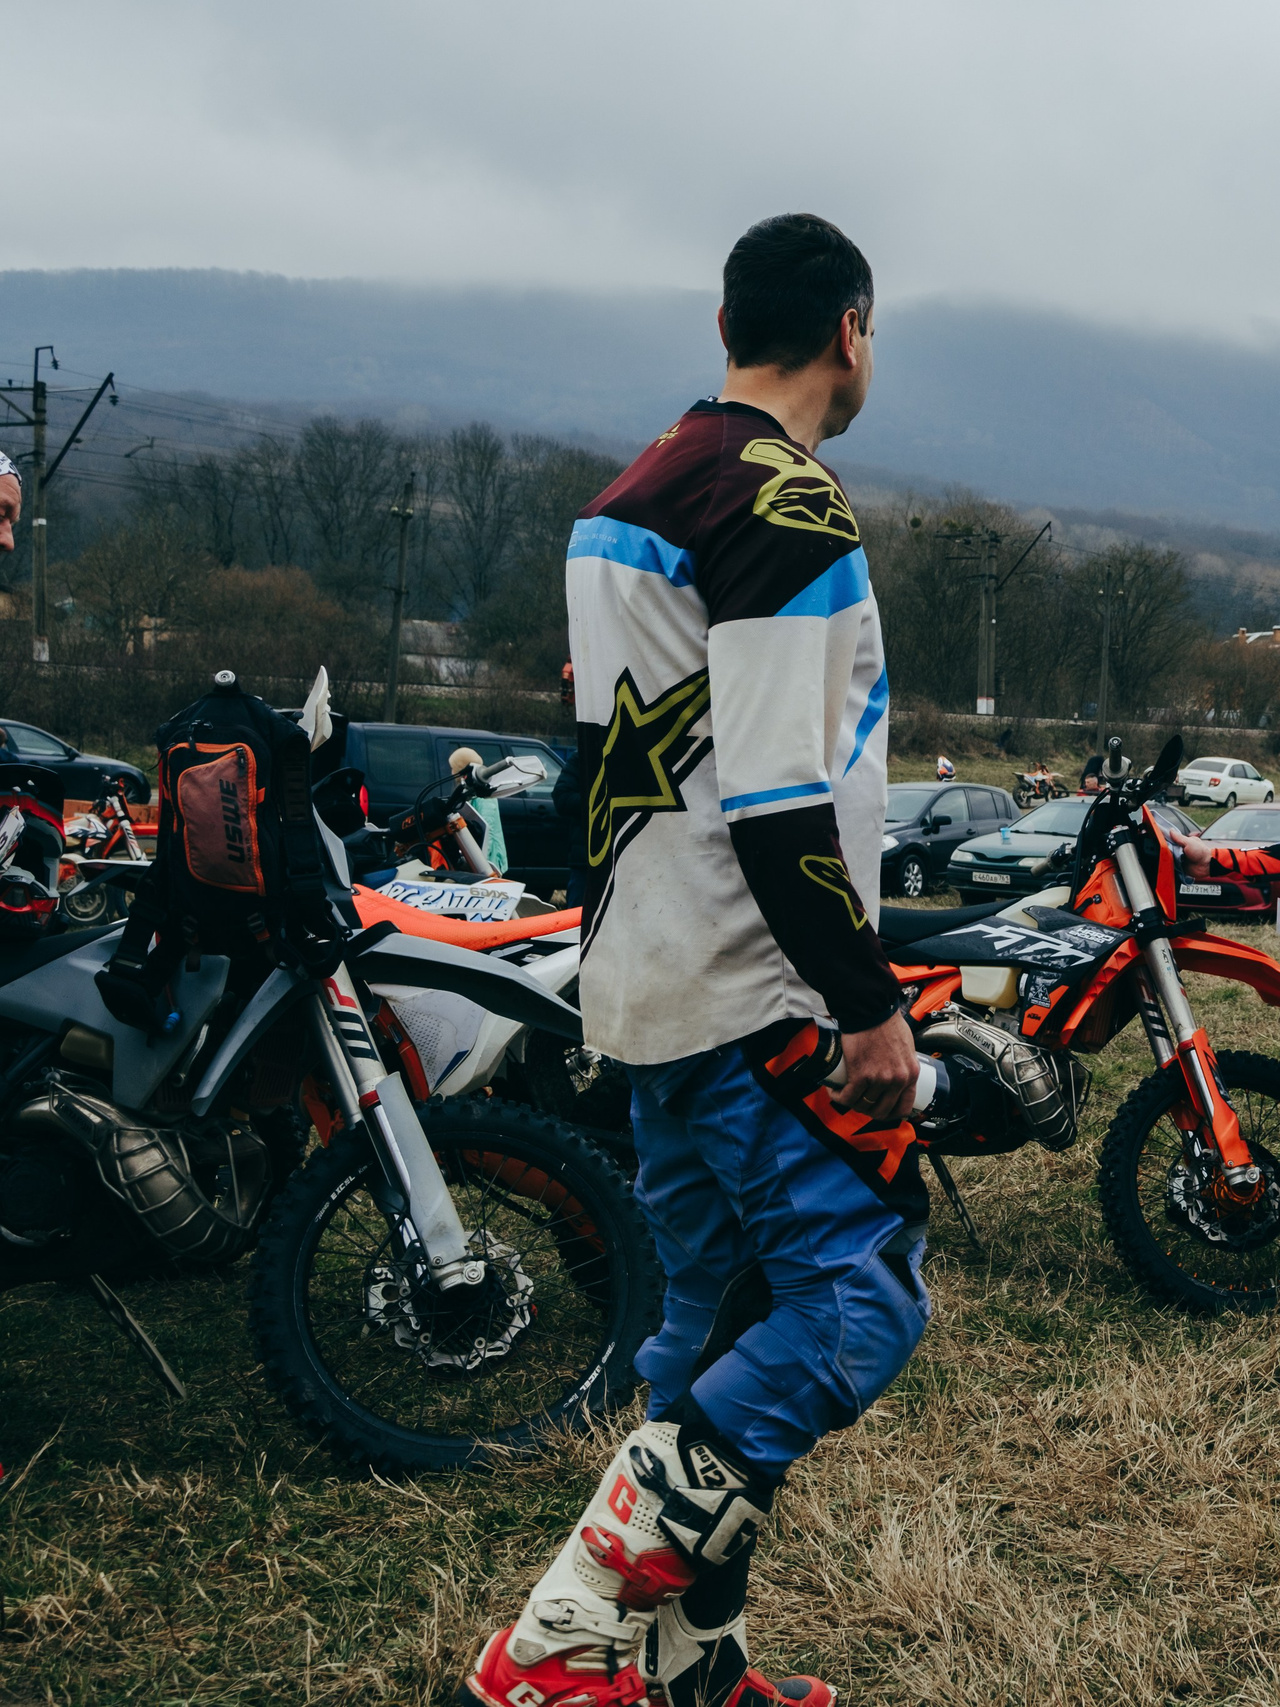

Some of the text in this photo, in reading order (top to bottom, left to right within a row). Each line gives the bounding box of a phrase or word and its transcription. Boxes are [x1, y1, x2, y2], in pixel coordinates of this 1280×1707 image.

[219, 779, 246, 863] USWE
[330, 1174, 356, 1201] EXCEL
[579, 1364, 603, 1391] EXCEL
